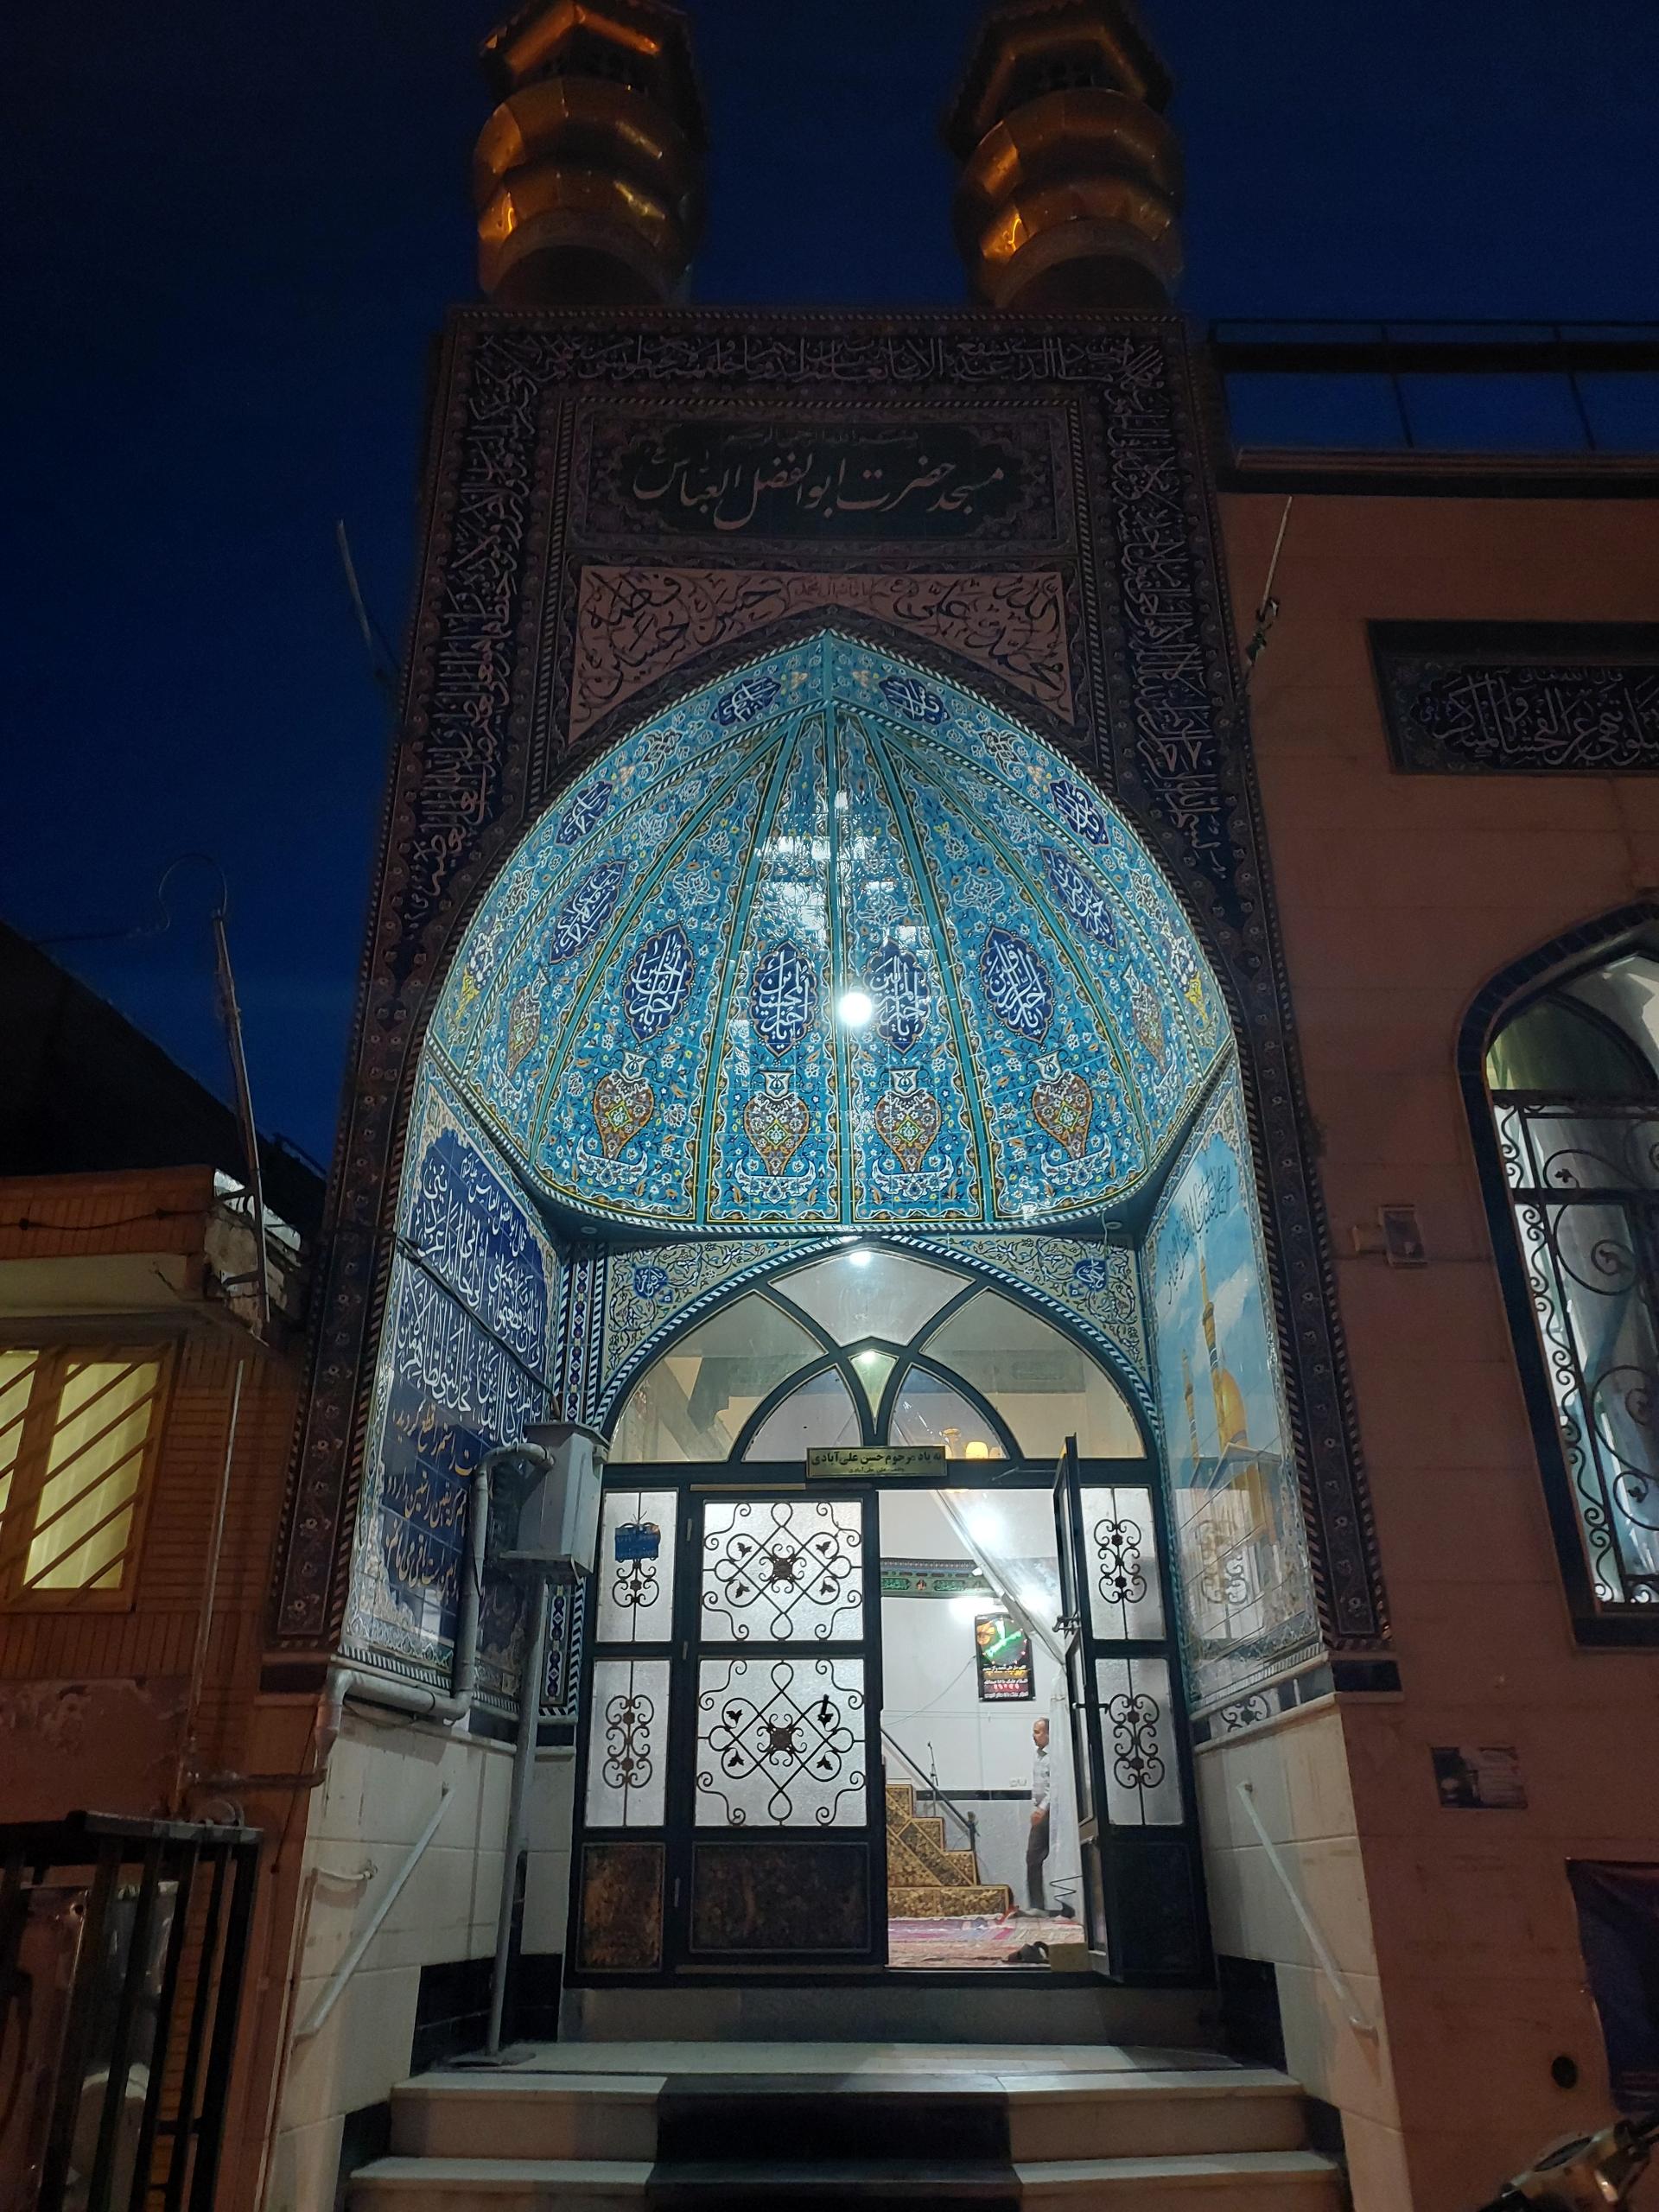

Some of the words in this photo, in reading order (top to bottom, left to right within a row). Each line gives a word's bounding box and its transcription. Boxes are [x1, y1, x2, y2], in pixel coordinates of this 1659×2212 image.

[632, 463, 741, 513] العباس
[714, 452, 847, 531] ابوالفضل
[836, 455, 957, 513] حضرت
[927, 467, 1004, 514] مسجد
[811, 1451, 839, 1466] آبادی
[838, 1452, 858, 1465] علی
[860, 1453, 884, 1465] حسن
[885, 1454, 916, 1465] مرحوم
[918, 1452, 931, 1464] یاد
